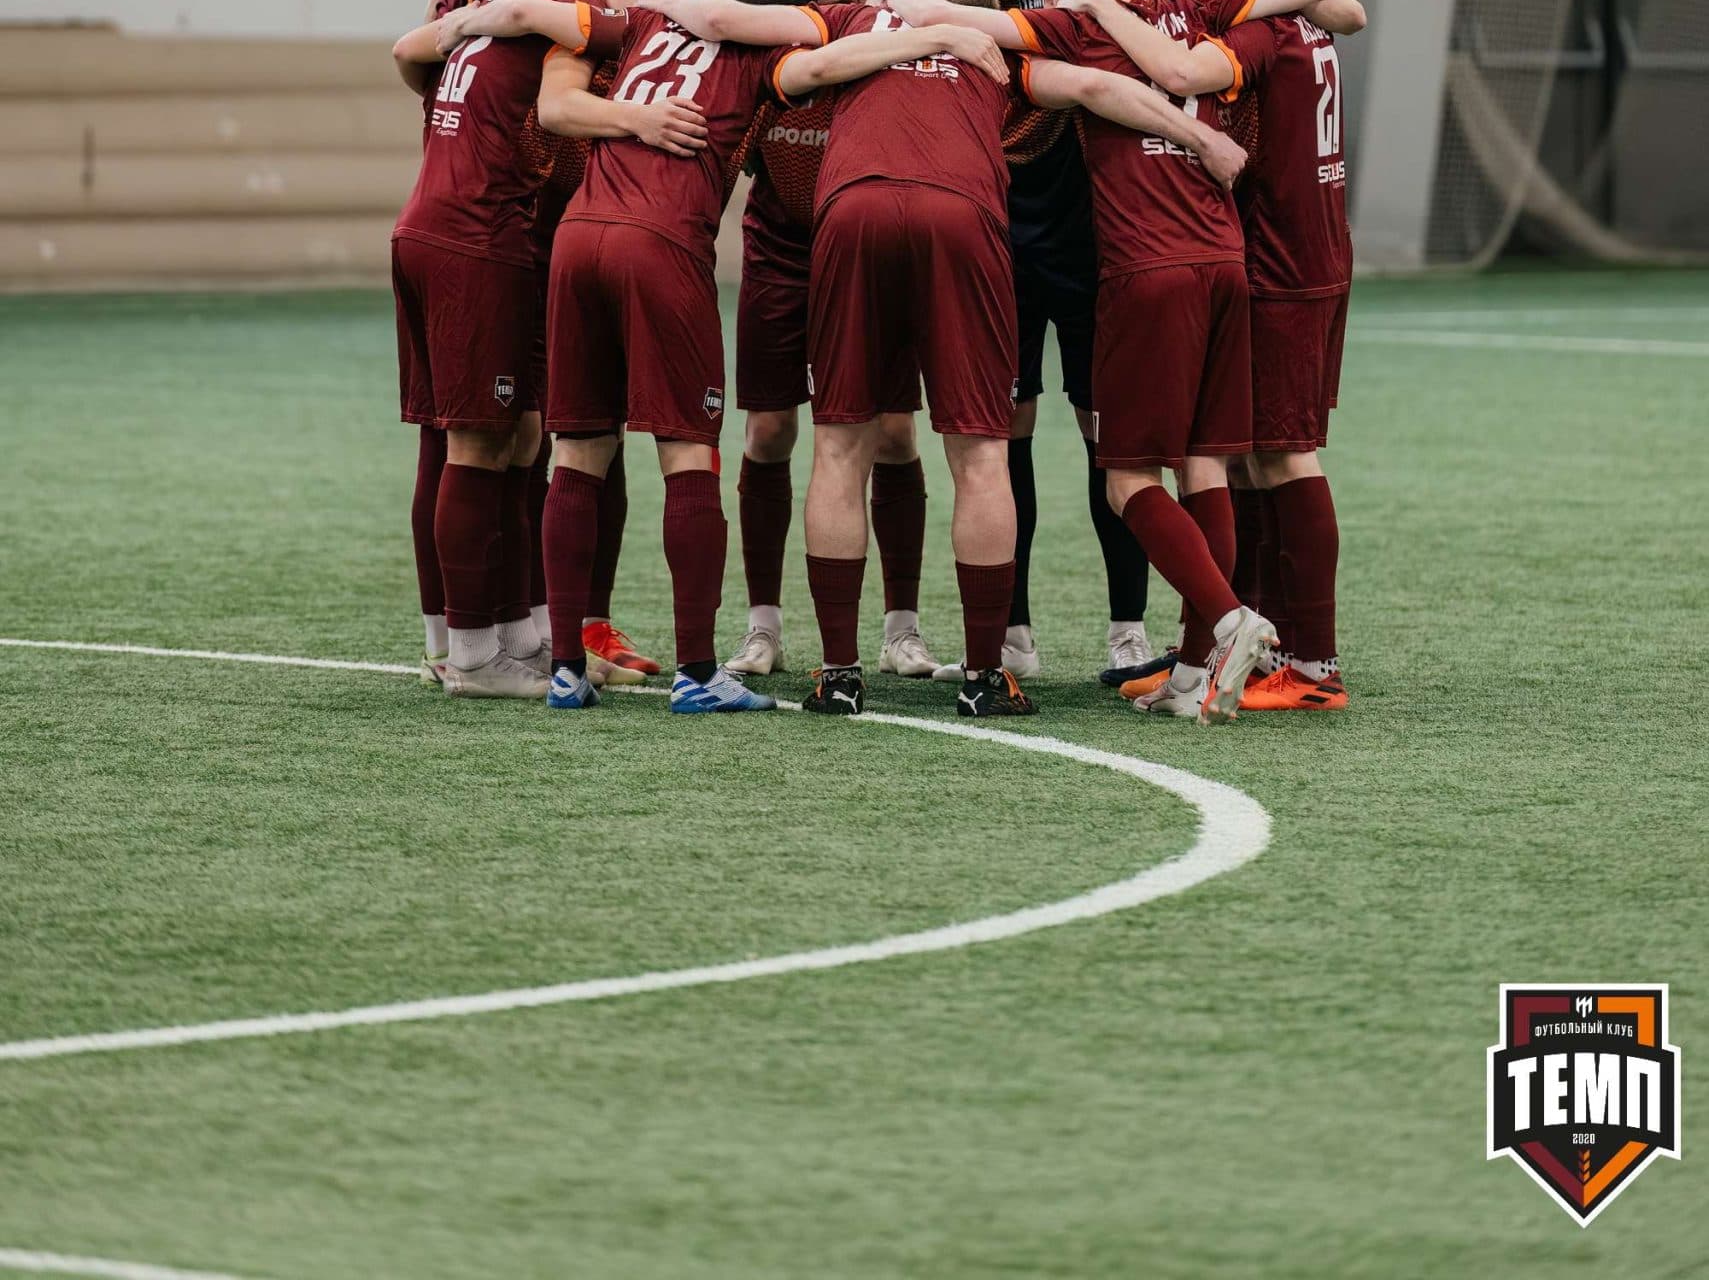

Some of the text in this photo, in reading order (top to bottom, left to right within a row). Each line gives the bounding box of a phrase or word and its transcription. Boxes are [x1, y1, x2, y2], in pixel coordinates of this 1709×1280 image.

[613, 31, 720, 105] 23
[883, 59, 959, 79] EUS
[1312, 46, 1340, 157] 21
